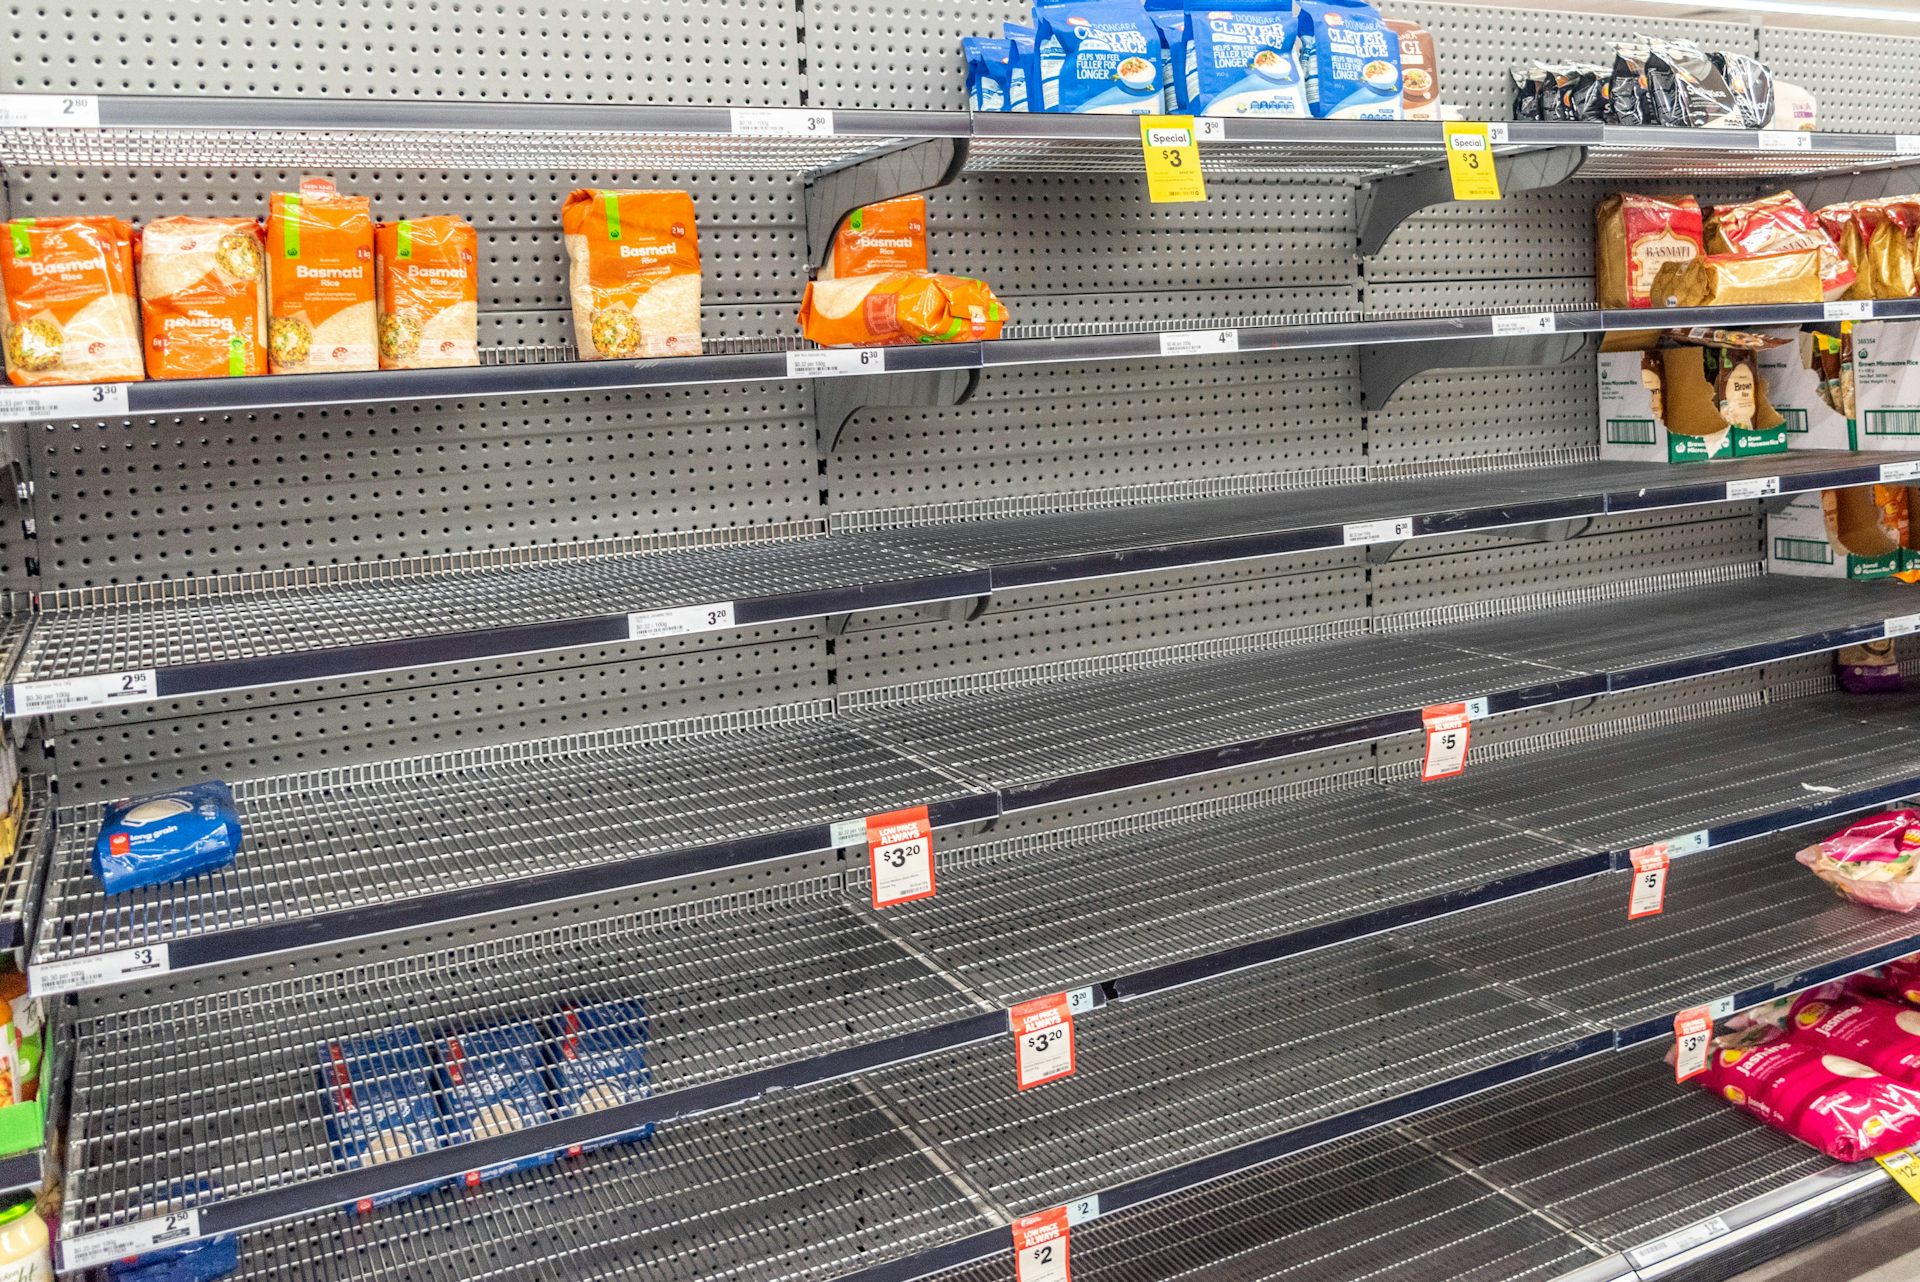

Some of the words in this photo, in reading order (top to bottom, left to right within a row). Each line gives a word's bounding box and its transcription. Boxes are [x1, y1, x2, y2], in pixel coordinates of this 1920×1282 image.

[1074, 25, 1146, 44] CLEVER
[1210, 20, 1285, 37] CLEVER
[1247, 34, 1285, 50] RICE
[1327, 27, 1387, 46] CLEVER
[1112, 39, 1147, 54] RICE
[1355, 43, 1388, 59] RICE
[1095, 54, 1106, 62] YOU
[1107, 54, 1120, 62] FEEL
[1213, 51, 1240, 59] FULLER
[1241, 51, 1254, 59] FOR
[1076, 60, 1104, 70] FULLER
[1105, 60, 1116, 70] FOR
[1214, 58, 1248, 69] LONGER
[1332, 61, 1351, 70] FULLER
[1076, 69, 1110, 80] LONGER
[1333, 70, 1359, 81] LONGER
[1153, 133, 1187, 145] Special
[1454, 138, 1482, 147] Special
[1162, 149, 1182, 168] $3
[1462, 153, 1479, 169] $3
[861, 236, 913, 249] Basmati
[363, 250, 371, 260] kg
[620, 242, 677, 259] Basmati
[879, 248, 895, 256] Rice
[1645, 246, 1691, 258] BASMATI
[641, 257, 658, 265] Rice
[61, 273, 83, 281] Rice
[296, 265, 363, 279] Basmati
[408, 265, 468, 279] Basmati
[320, 279, 341, 288] Rice
[430, 278, 448, 286] Rice
[1441, 733, 1456, 750] $5
[130, 831, 154, 844] long
[153, 824, 178, 840] grain
[880, 830, 921, 845] ALWAYS
[1645, 873, 1657, 888] $5
[134, 948, 153, 965] $3
[1815, 1005, 1863, 1038] Jasmine
[1736, 1042, 1791, 1077] Jasmine
[1025, 1229, 1060, 1247] ALWAYS
[1034, 1246, 1053, 1265] $2
